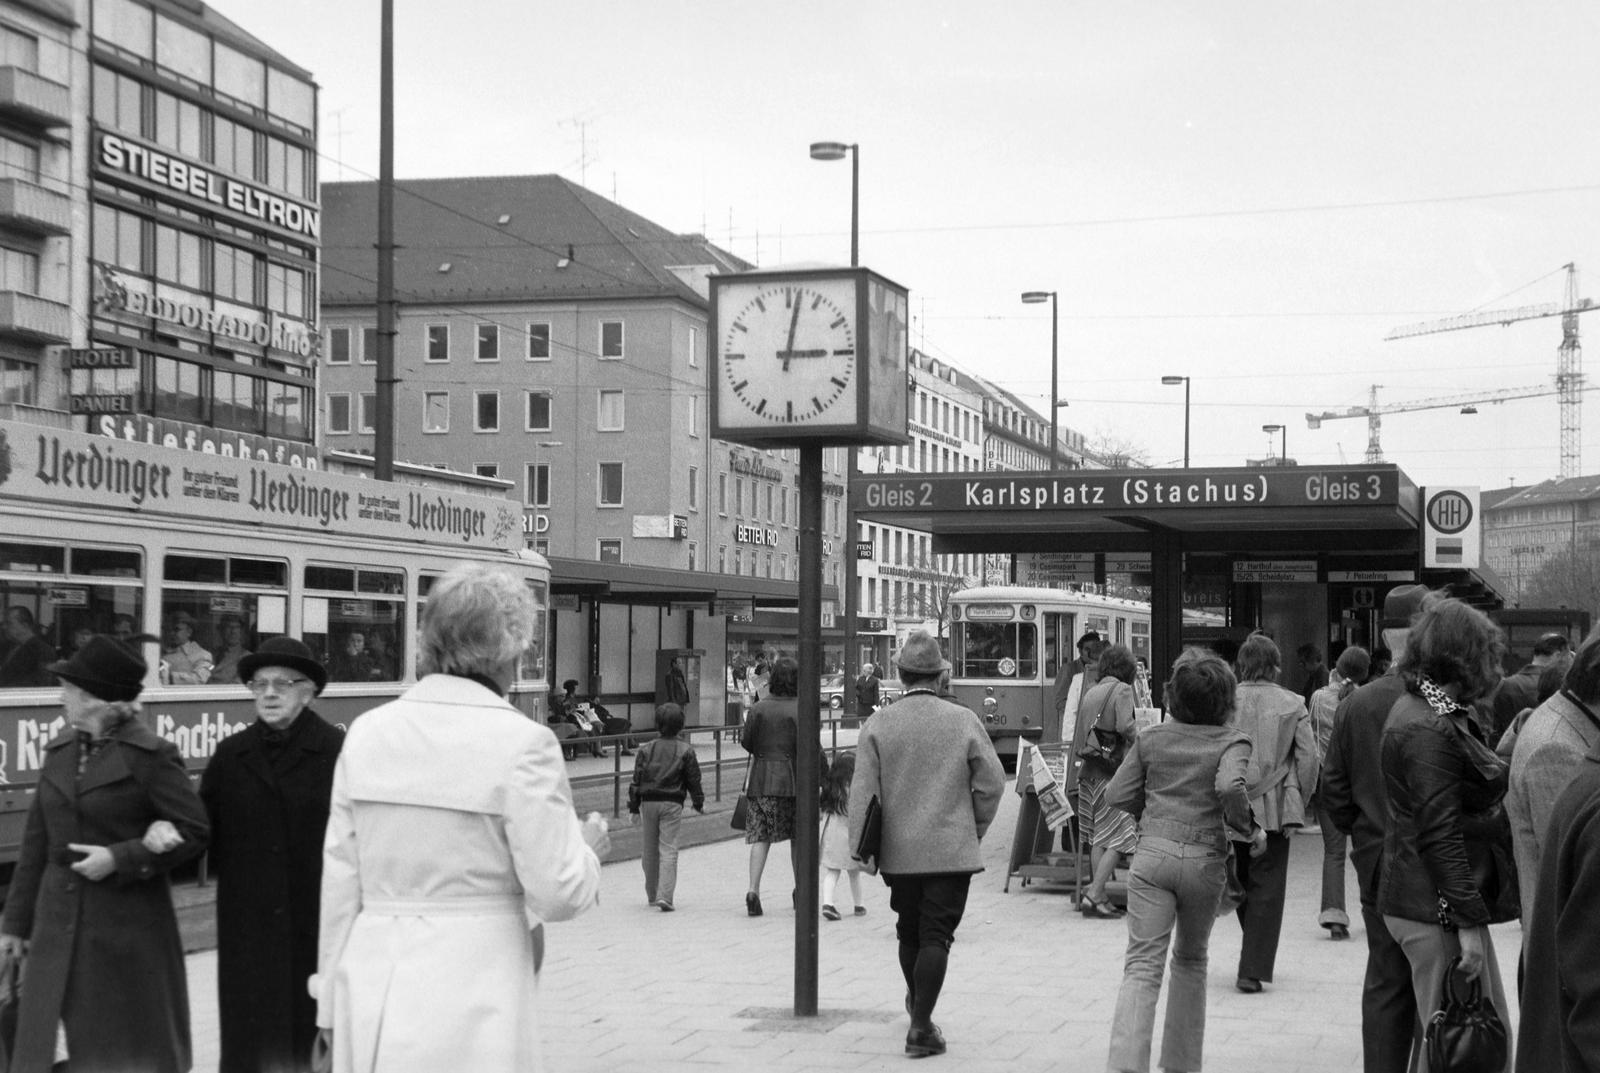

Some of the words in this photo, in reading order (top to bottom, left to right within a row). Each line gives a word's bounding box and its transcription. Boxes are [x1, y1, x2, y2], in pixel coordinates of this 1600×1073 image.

[102, 135, 222, 204] STIEBEL
[227, 180, 319, 239] ELTRON
[125, 291, 270, 346] ELDORADO
[72, 350, 130, 366] HOTEL
[71, 396, 130, 412] DANIEL
[35, 434, 172, 505] Uerdinger
[248, 467, 350, 527] Uerdinger
[866, 482, 915, 507] Gleis
[919, 482, 933, 506] 2
[965, 480, 1105, 510] Karlsplatz
[1122, 475, 1268, 505] (Stachus)
[1306, 475, 1361, 501] Gleis
[1367, 475, 1382, 500] 3
[407, 491, 487, 542] Uerdinger
[738, 525, 766, 545] BETTEN
